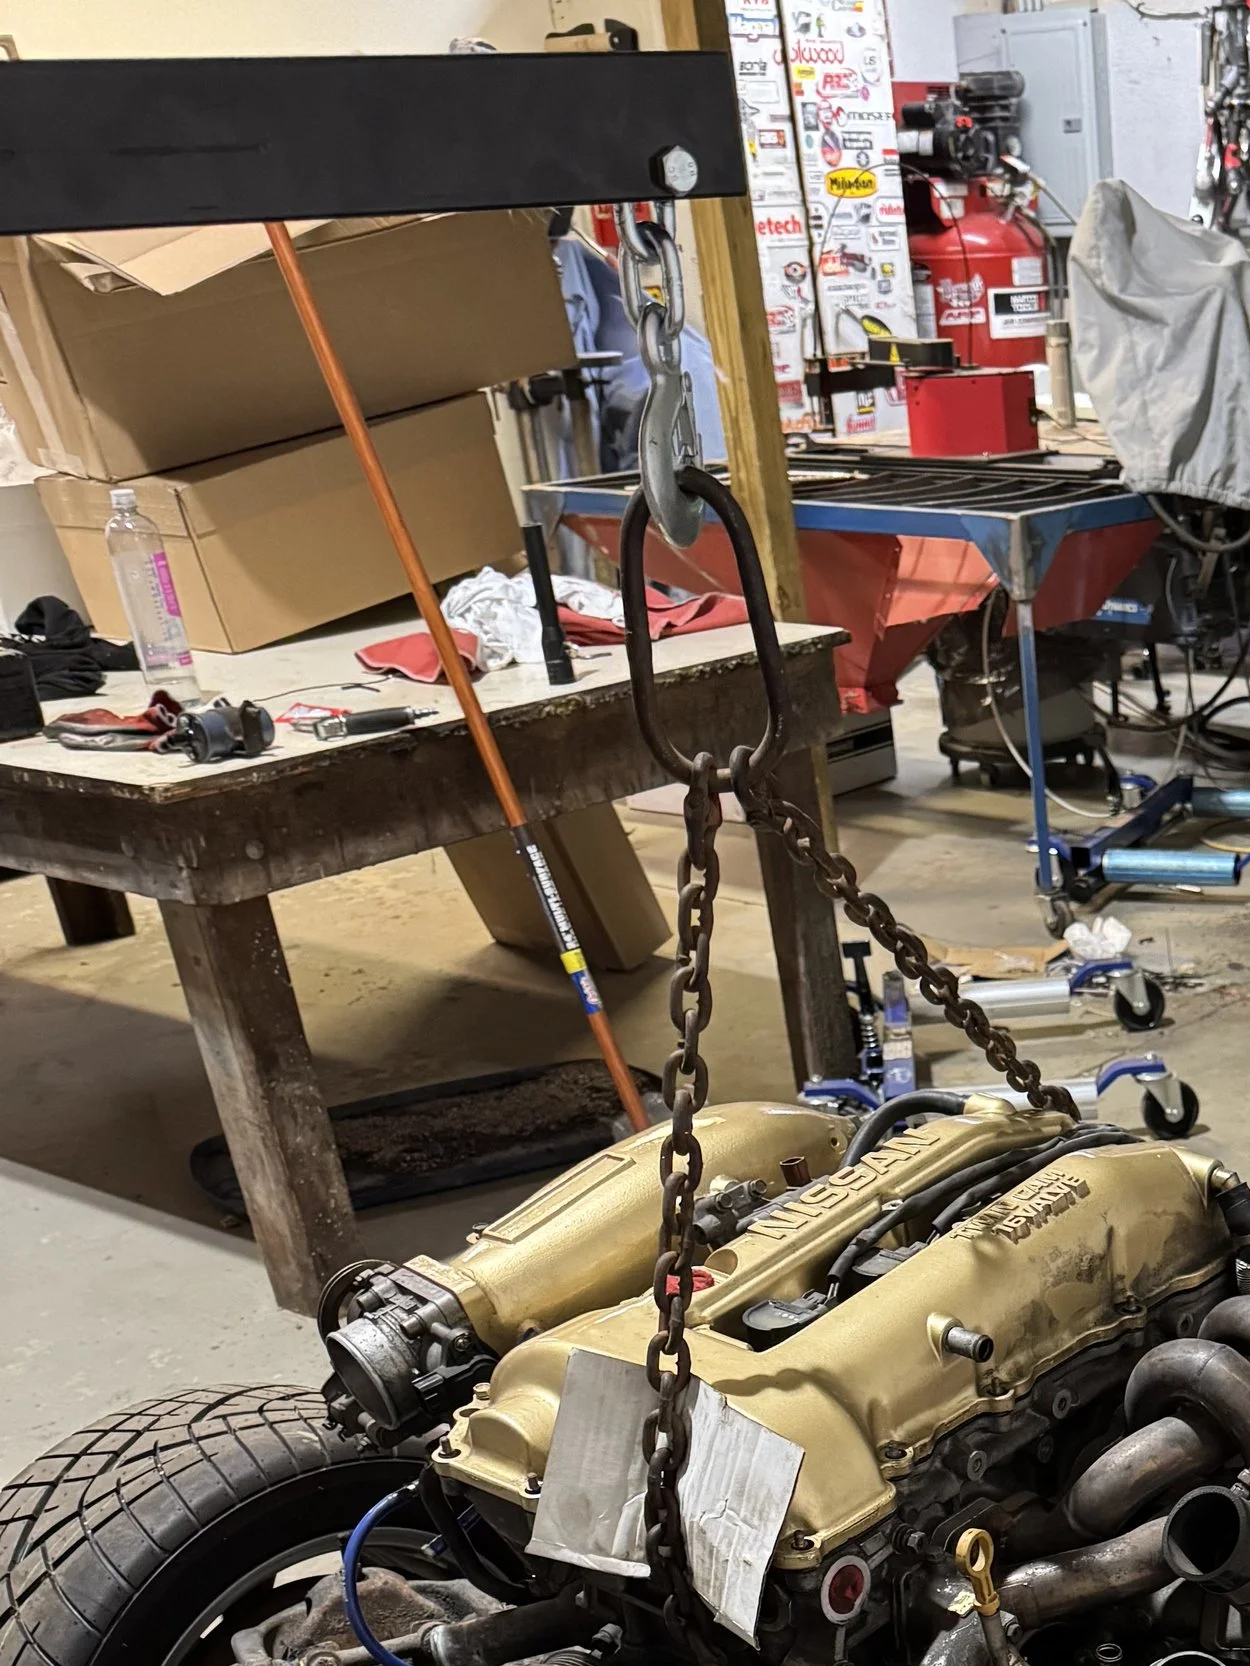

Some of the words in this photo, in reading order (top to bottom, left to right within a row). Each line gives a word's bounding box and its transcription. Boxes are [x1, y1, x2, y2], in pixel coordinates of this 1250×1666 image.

[747, 1128, 941, 1240] NISSAN
[949, 1199, 1020, 1240] TWIN
[1013, 1169, 1066, 1201] CAM
